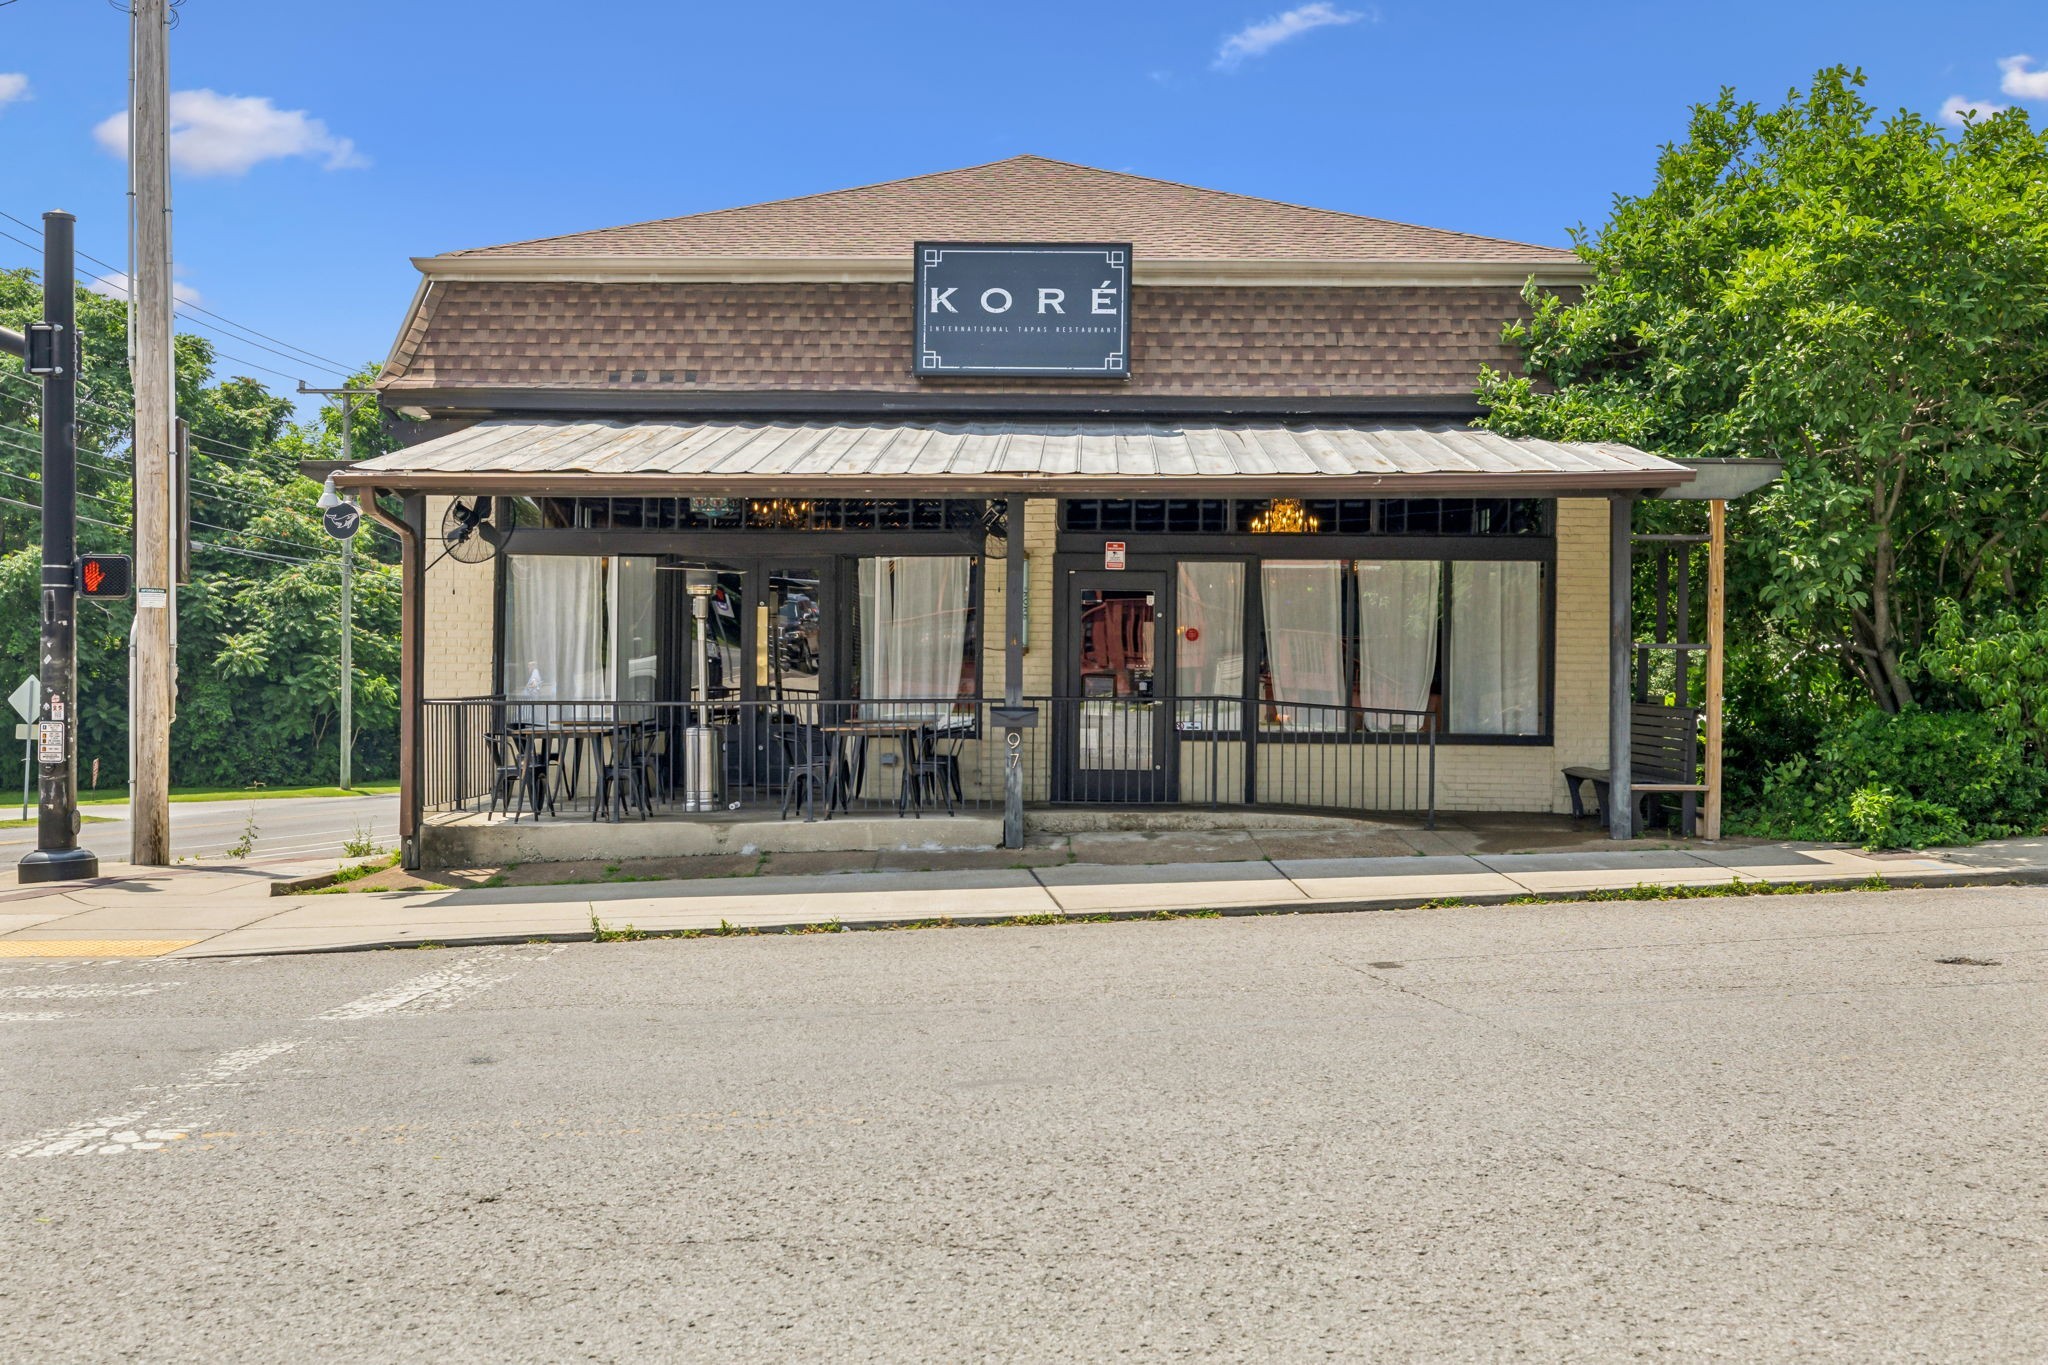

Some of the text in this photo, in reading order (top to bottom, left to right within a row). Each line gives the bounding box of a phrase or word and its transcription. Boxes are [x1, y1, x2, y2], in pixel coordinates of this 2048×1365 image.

[930, 280, 1117, 315] KORÉ
[929, 325, 1009, 333] INTERNATIONAL
[1055, 326, 1117, 334] RESTAURANT
